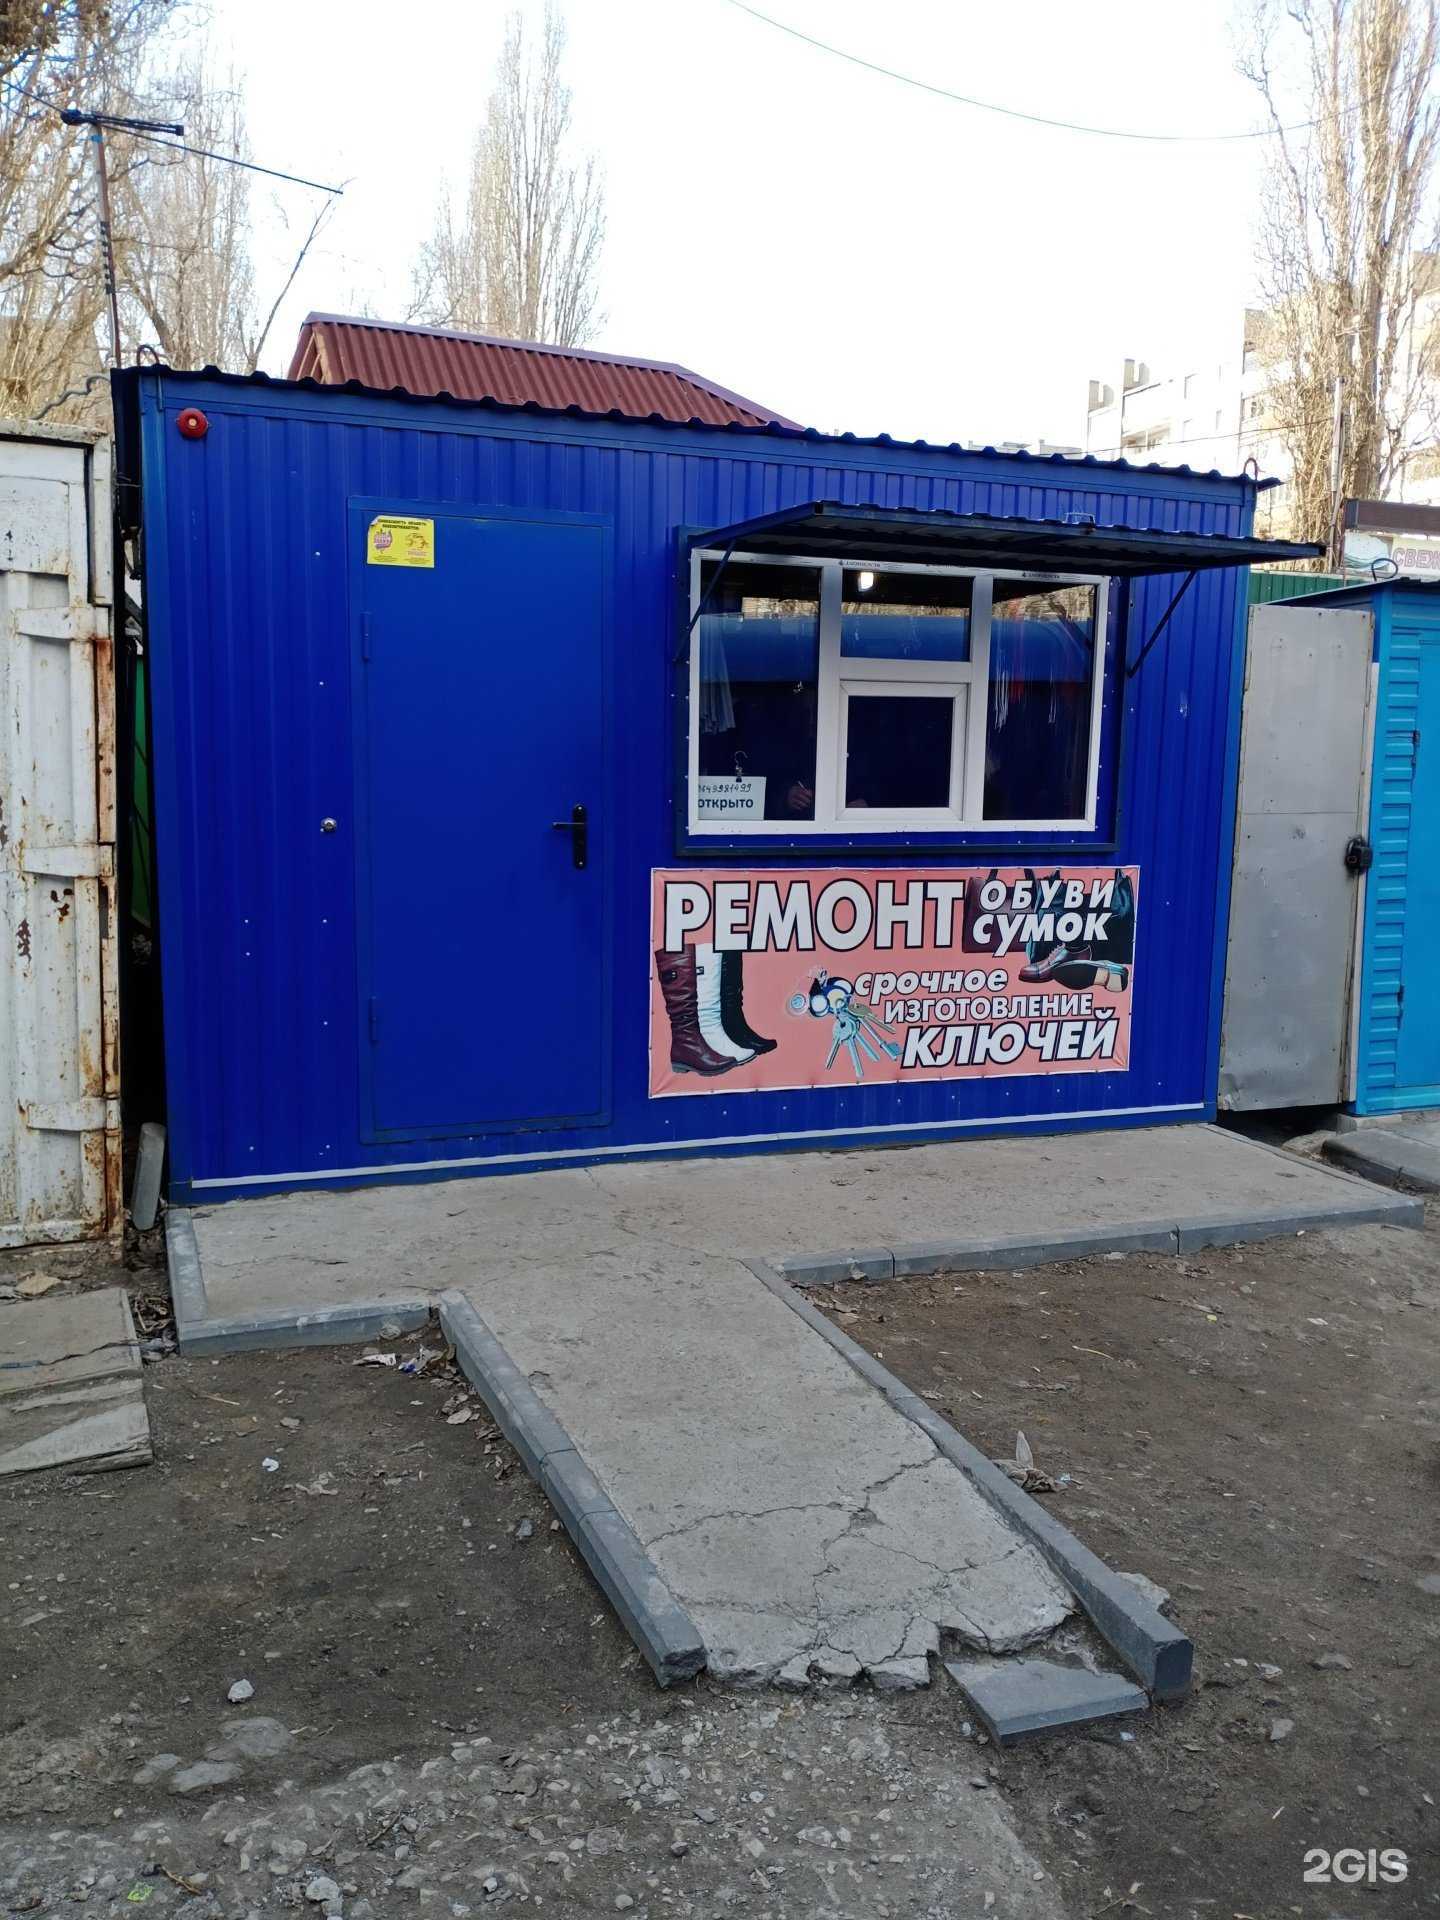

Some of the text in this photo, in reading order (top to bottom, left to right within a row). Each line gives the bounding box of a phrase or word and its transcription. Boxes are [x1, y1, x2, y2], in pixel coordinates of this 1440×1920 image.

[698, 798, 754, 811] открыто
[663, 878, 1115, 953] РЕМОНТ ОБУВИ
[971, 910, 1111, 958] сумок
[853, 967, 1009, 1006] срочное
[883, 992, 1094, 1025] ИЗГОТОВЛЕНИЕ
[901, 1007, 1120, 1069] КЛЮЧЕЙ
